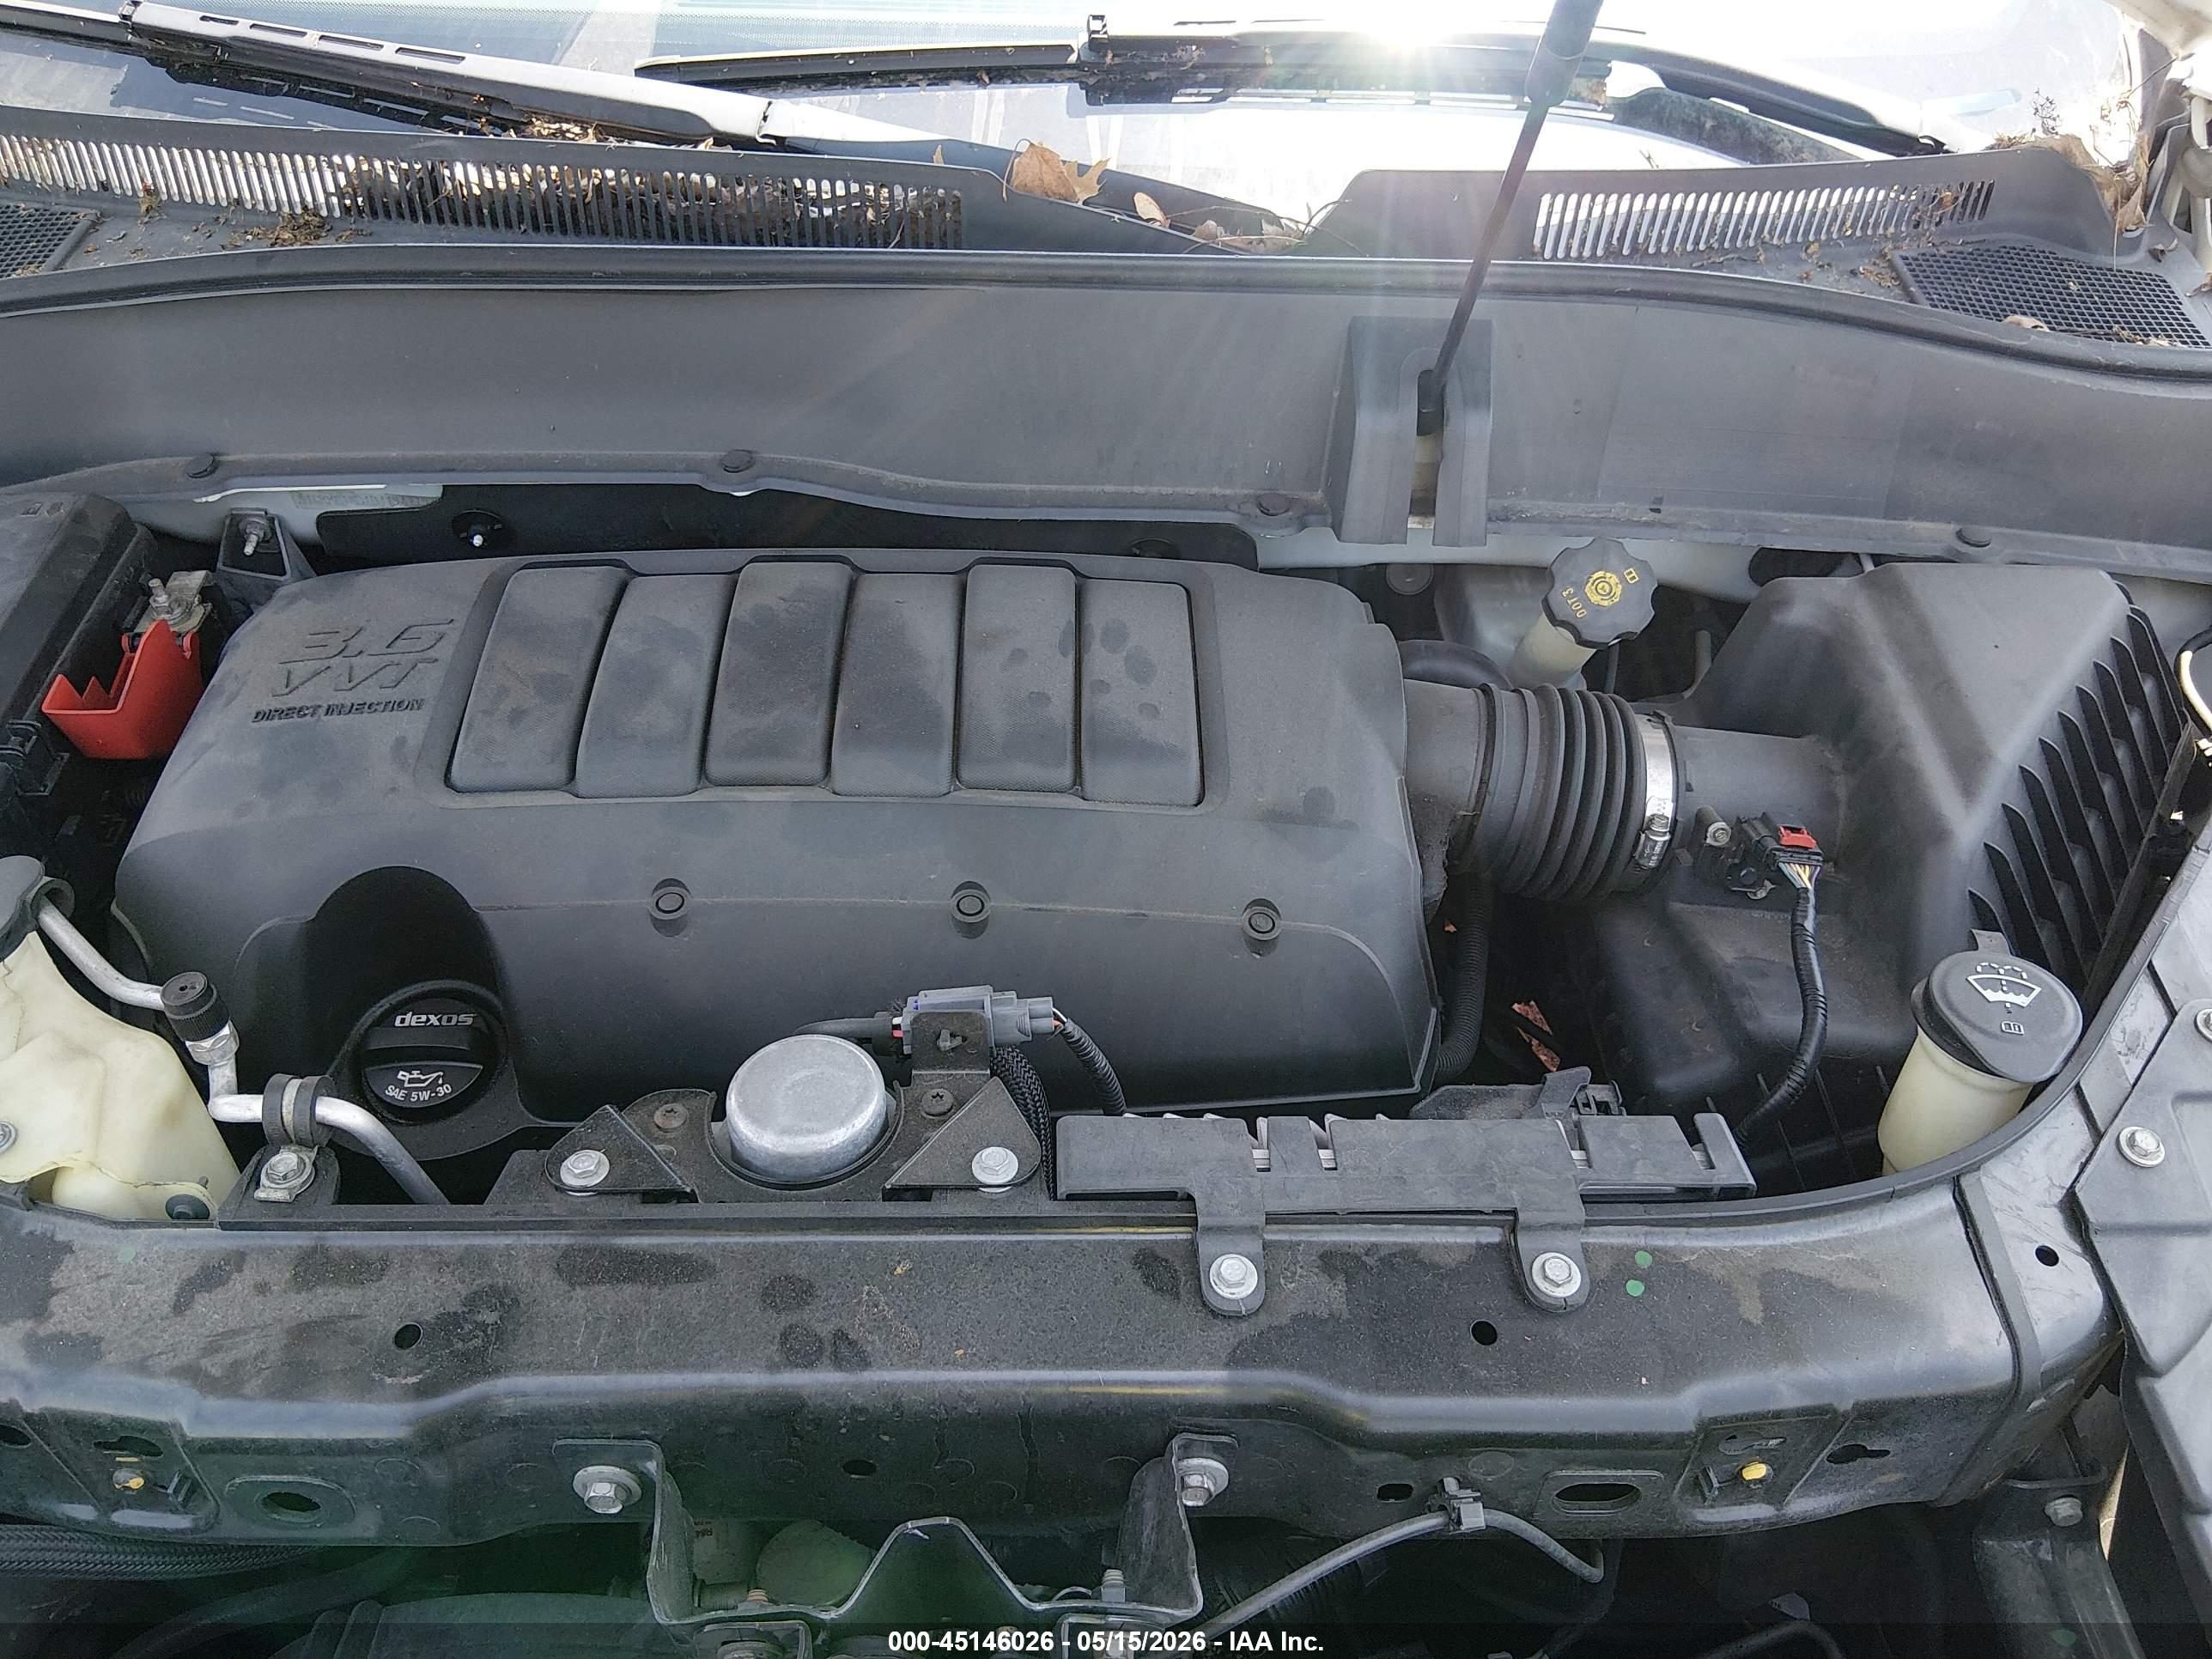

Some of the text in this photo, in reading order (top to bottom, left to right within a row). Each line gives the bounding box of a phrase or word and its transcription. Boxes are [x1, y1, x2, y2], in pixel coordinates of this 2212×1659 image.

[279, 618, 454, 665] 3.6
[271, 659, 438, 696] VVT
[252, 698, 425, 723] DIRECT INJECTION
[394, 1012, 477, 1027] dexos
[386, 1084, 452, 1102] SAE 5W-30
